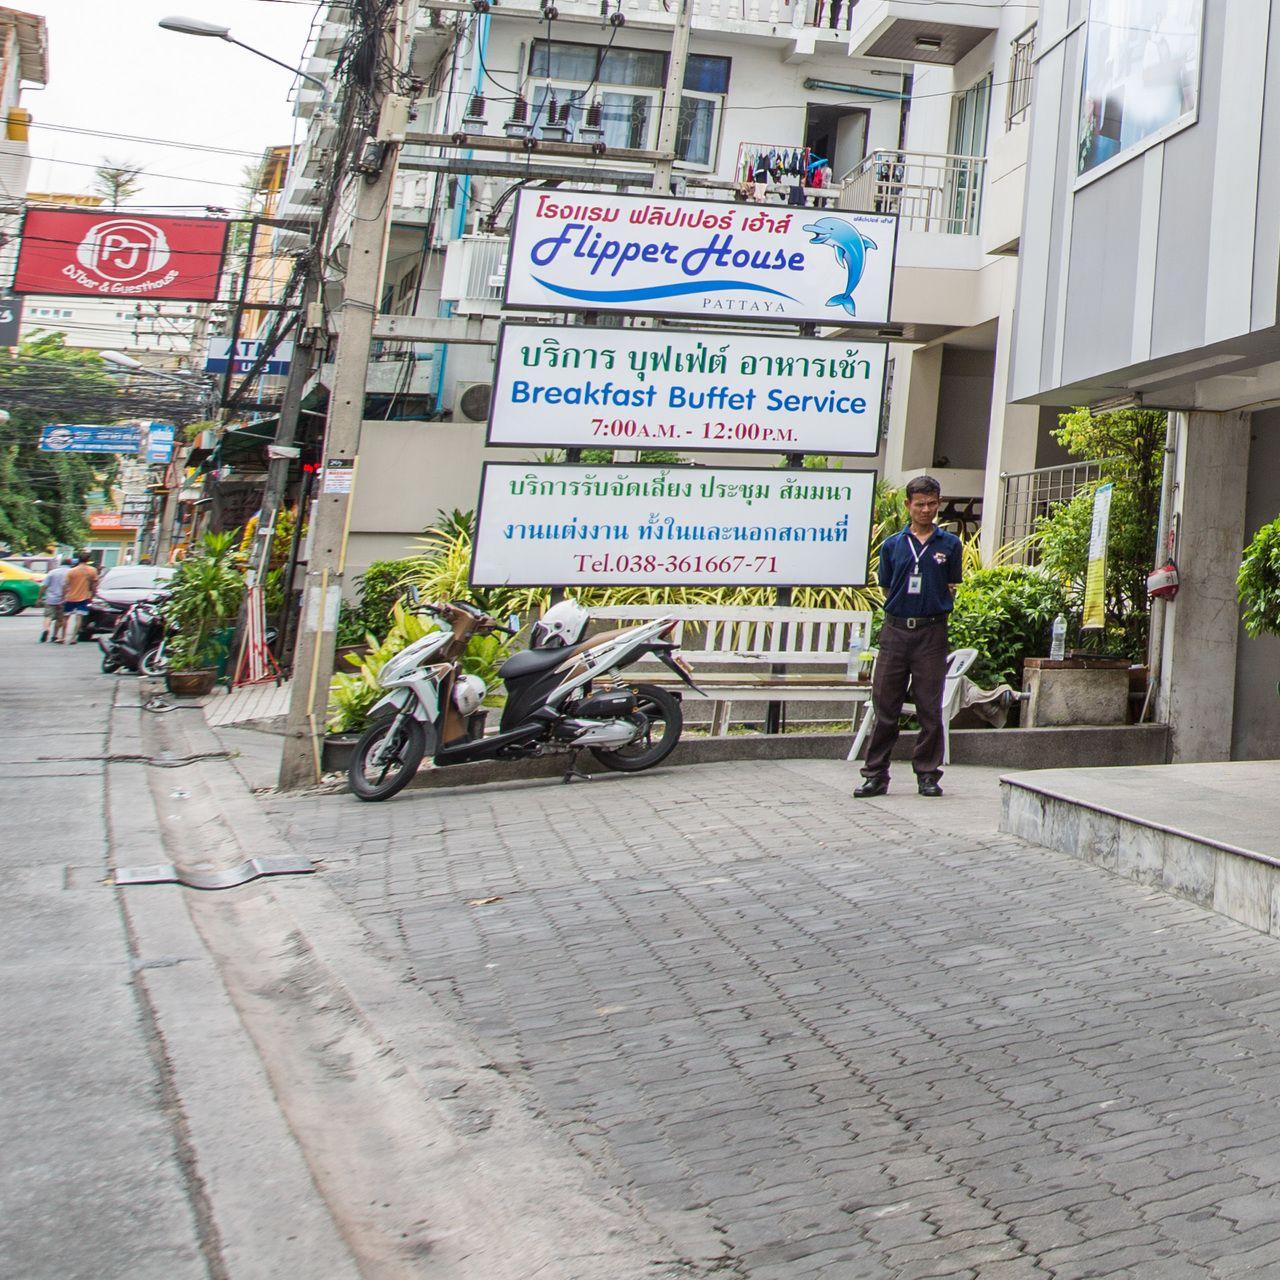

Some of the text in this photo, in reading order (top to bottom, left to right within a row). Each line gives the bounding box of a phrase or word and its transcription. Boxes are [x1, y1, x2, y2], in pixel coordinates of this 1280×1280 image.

[535, 194, 794, 234] โรงแรม ฟลิปเปอร์ เฮ้าส์
[101, 234, 149, 270] PJ
[530, 223, 805, 277] Flipper House
[98, 281, 111, 293] &
[110, 269, 180, 294] Guesthouse
[702, 297, 786, 313] PATTAYA
[520, 337, 872, 382] บริการ บุฟเฟ่ต์ อาหารเช้า
[511, 380, 867, 415] Breakfast Buffet Service
[508, 469, 852, 506] บริการรับจัดเลี้ยง ประชุม สัมมนา
[503, 512, 849, 544] งานแต่งงาน ทั้งในและนอกสถานที่
[574, 553, 779, 574] Tel.038-361667-71
